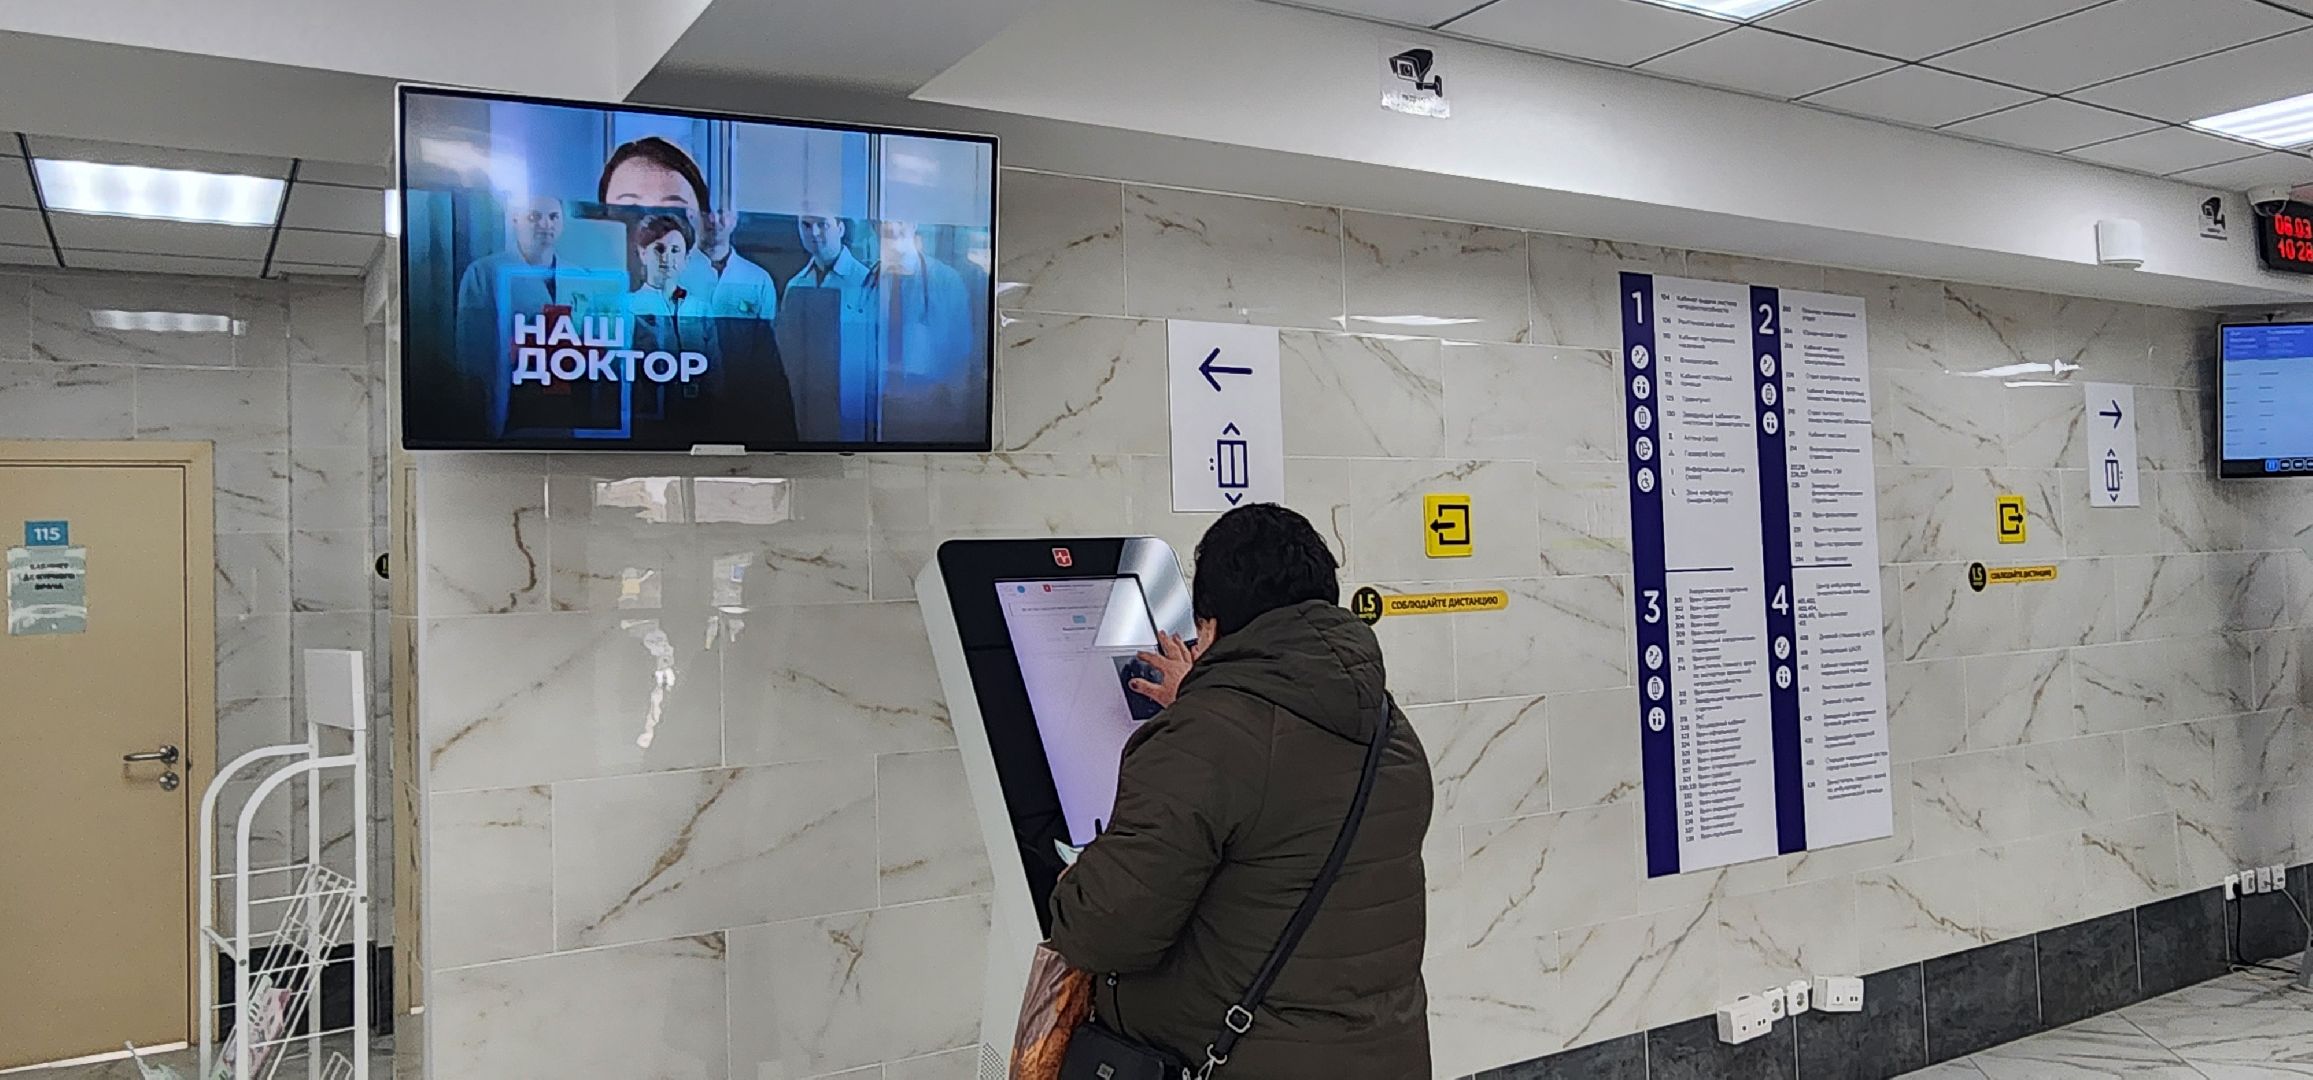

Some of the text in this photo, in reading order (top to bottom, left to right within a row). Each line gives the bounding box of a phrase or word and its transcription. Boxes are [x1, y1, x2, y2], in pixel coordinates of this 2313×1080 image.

[1631, 291, 1643, 324] 1
[1759, 304, 1775, 334] 2
[514, 314, 625, 347] НАШ
[513, 348, 707, 385] ДОКТОР
[34, 527, 61, 541] 115
[1391, 596, 1498, 609] СОБЛЮДАЙТЕ ДИСТАНЦИЮ
[1643, 590, 1661, 623] 3
[1771, 584, 1790, 615] 4
